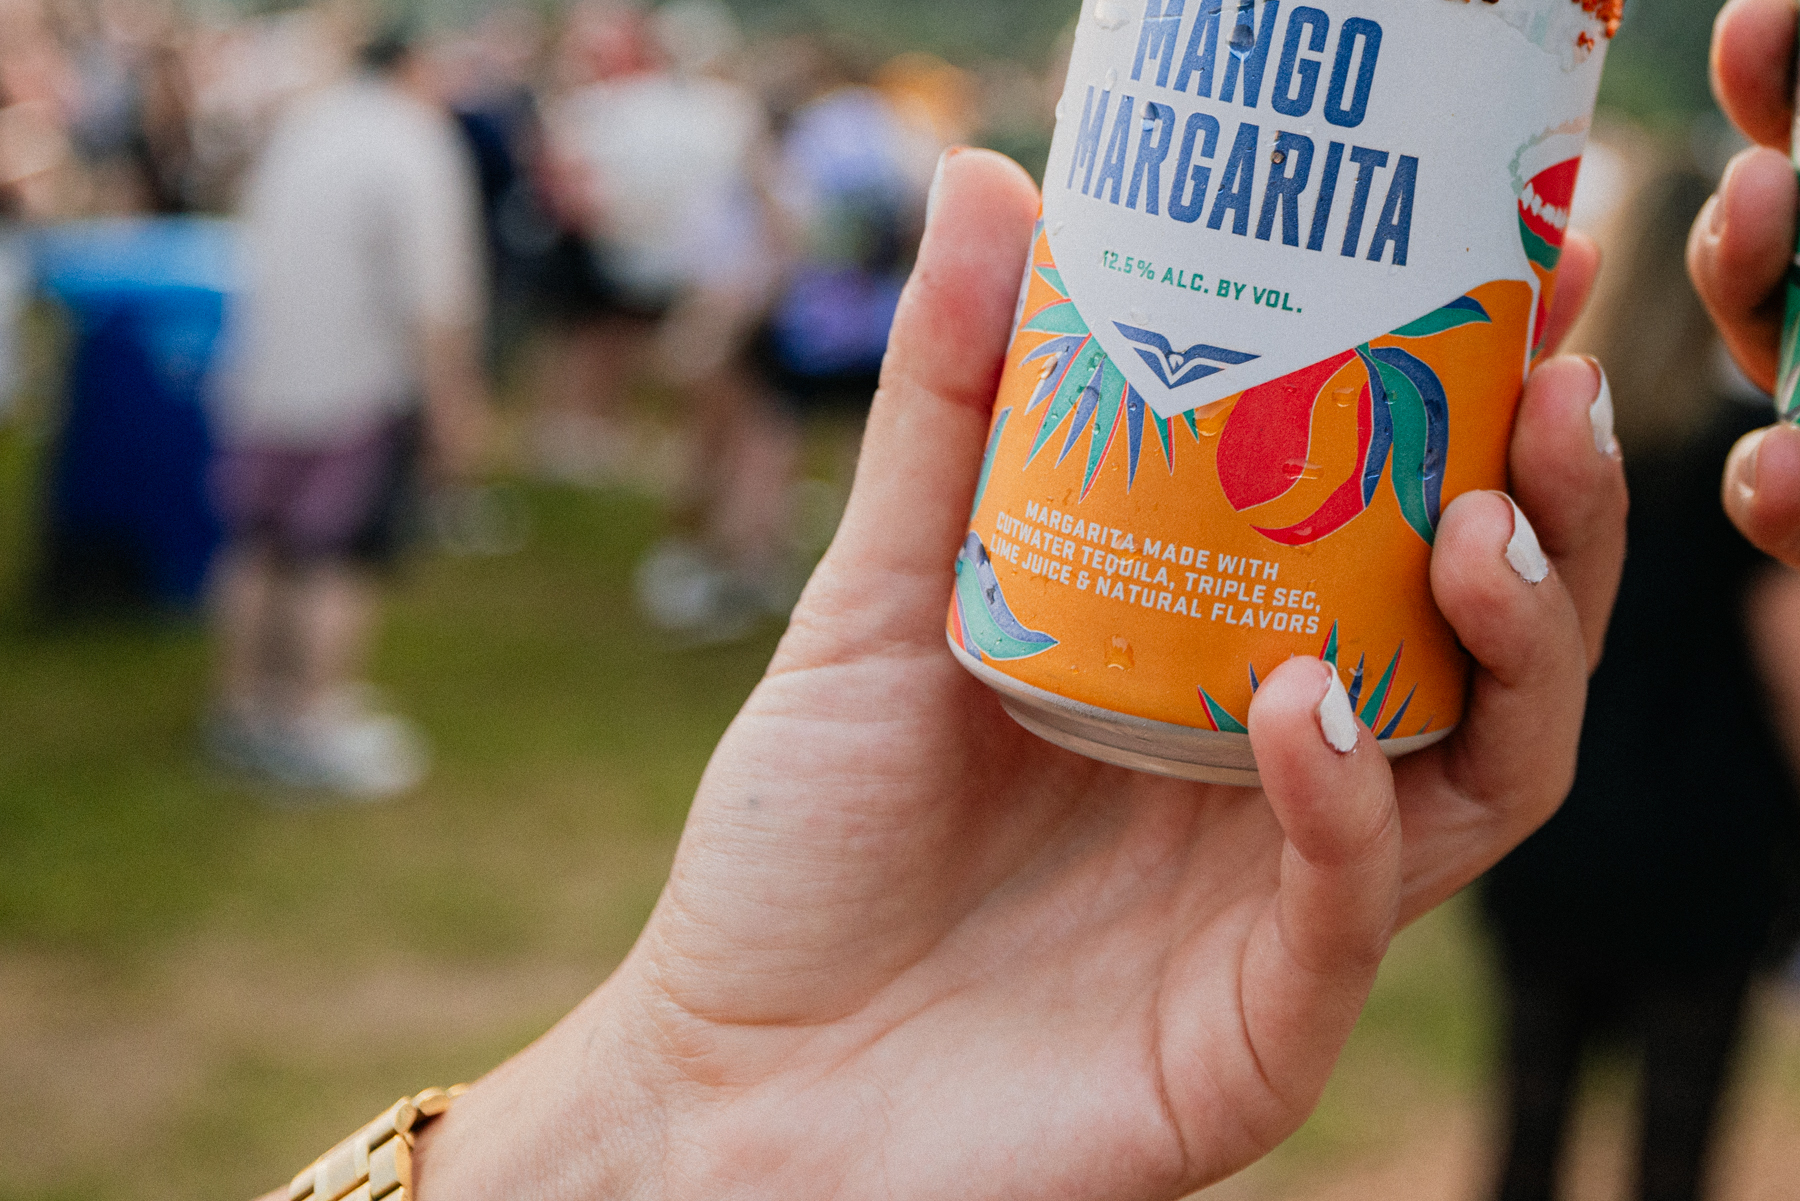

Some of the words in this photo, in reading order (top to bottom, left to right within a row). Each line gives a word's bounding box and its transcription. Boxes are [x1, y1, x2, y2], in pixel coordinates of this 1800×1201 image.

[1066, 84, 1420, 267] MARGARITA
[1160, 266, 1209, 294] ALC.
[1216, 278, 1247, 301] BY
[1252, 285, 1303, 314] VOL.
[989, 533, 1021, 565] LIME
[1021, 551, 1073, 586] JUICE
[1076, 570, 1091, 591] &
[1095, 575, 1203, 619] NATURAL
[1210, 602, 1320, 635] FLAVORS
[996, 510, 1076, 561] CUTWATER
[1081, 545, 1175, 591] TEQUILA,
[1185, 571, 1267, 604] TRIPLE
[1272, 586, 1321, 614] SEC,
[1025, 499, 1135, 553] MARGARITA
[1142, 537, 1211, 570] MADE
[1217, 552, 1280, 582] WITH
